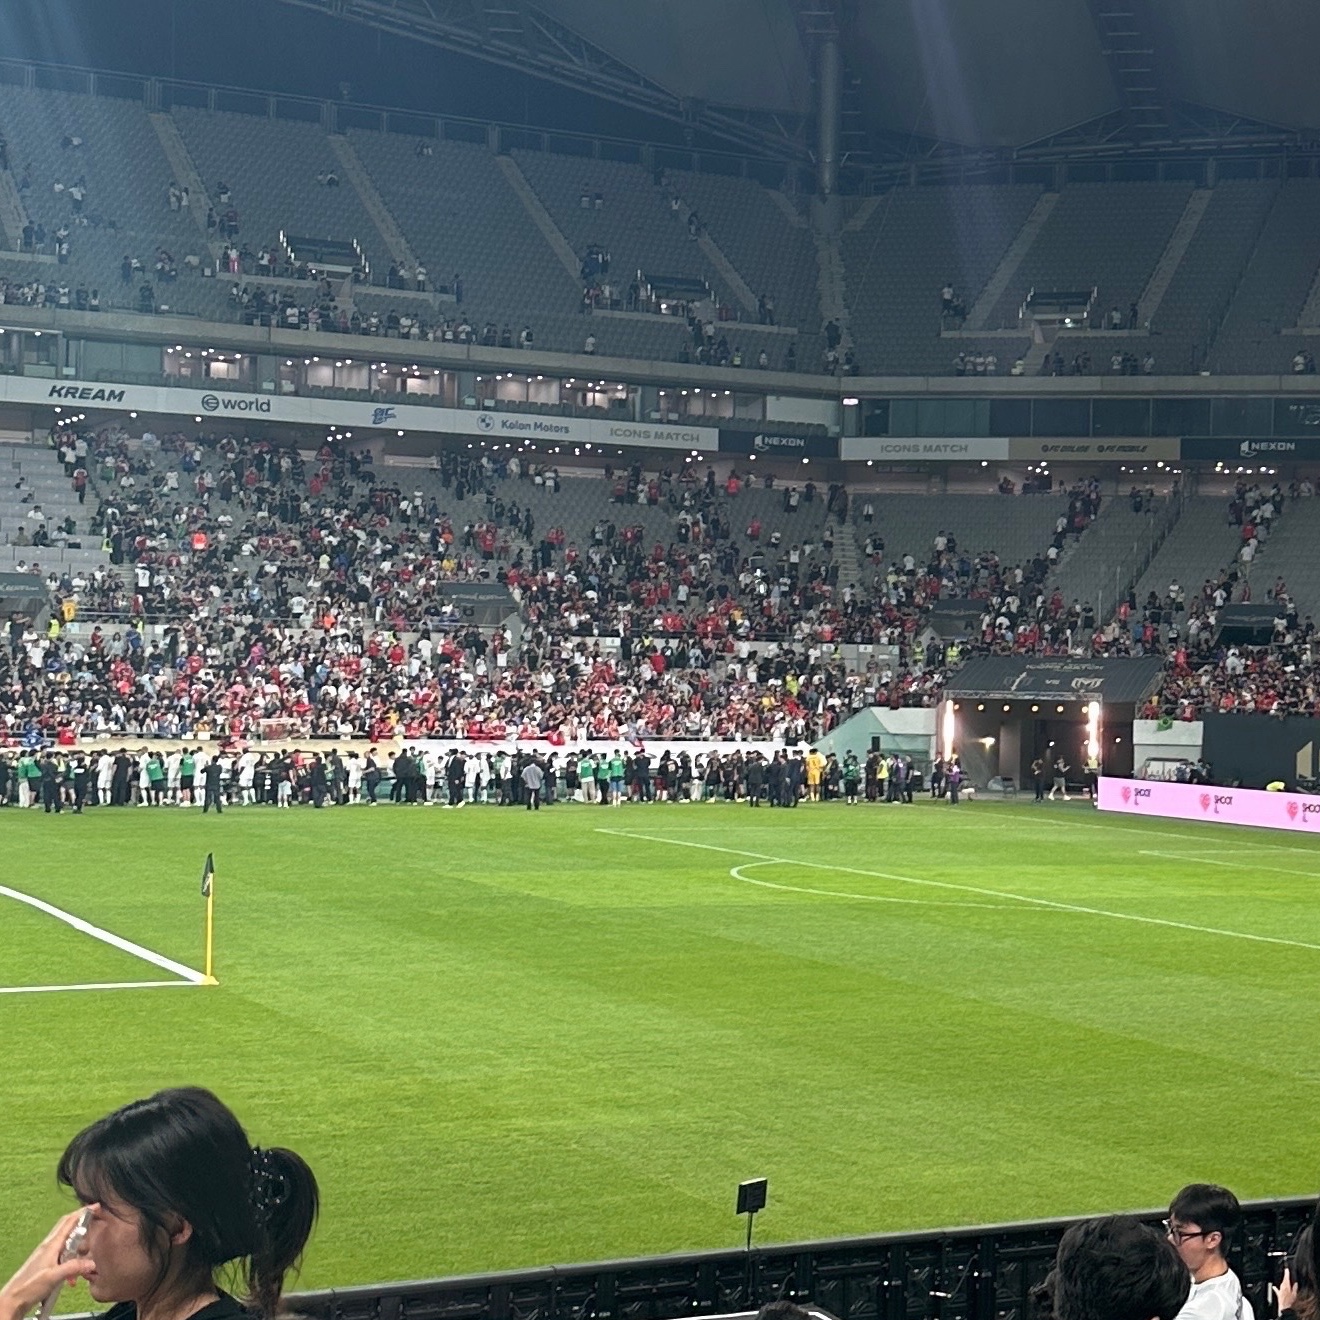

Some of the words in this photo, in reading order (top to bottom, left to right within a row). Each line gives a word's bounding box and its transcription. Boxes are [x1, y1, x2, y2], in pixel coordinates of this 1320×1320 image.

[48, 385, 126, 403] KREAM
[222, 398, 271, 413] world
[501, 419, 531, 432] Kolon
[533, 421, 570, 435] Motors
[610, 427, 650, 441] ICONS
[654, 430, 700, 443] MATCH
[765, 435, 804, 447] NEXON
[880, 444, 920, 454] ICONS
[922, 444, 968, 454] MATCH
[1251, 442, 1296, 453] NEXON
